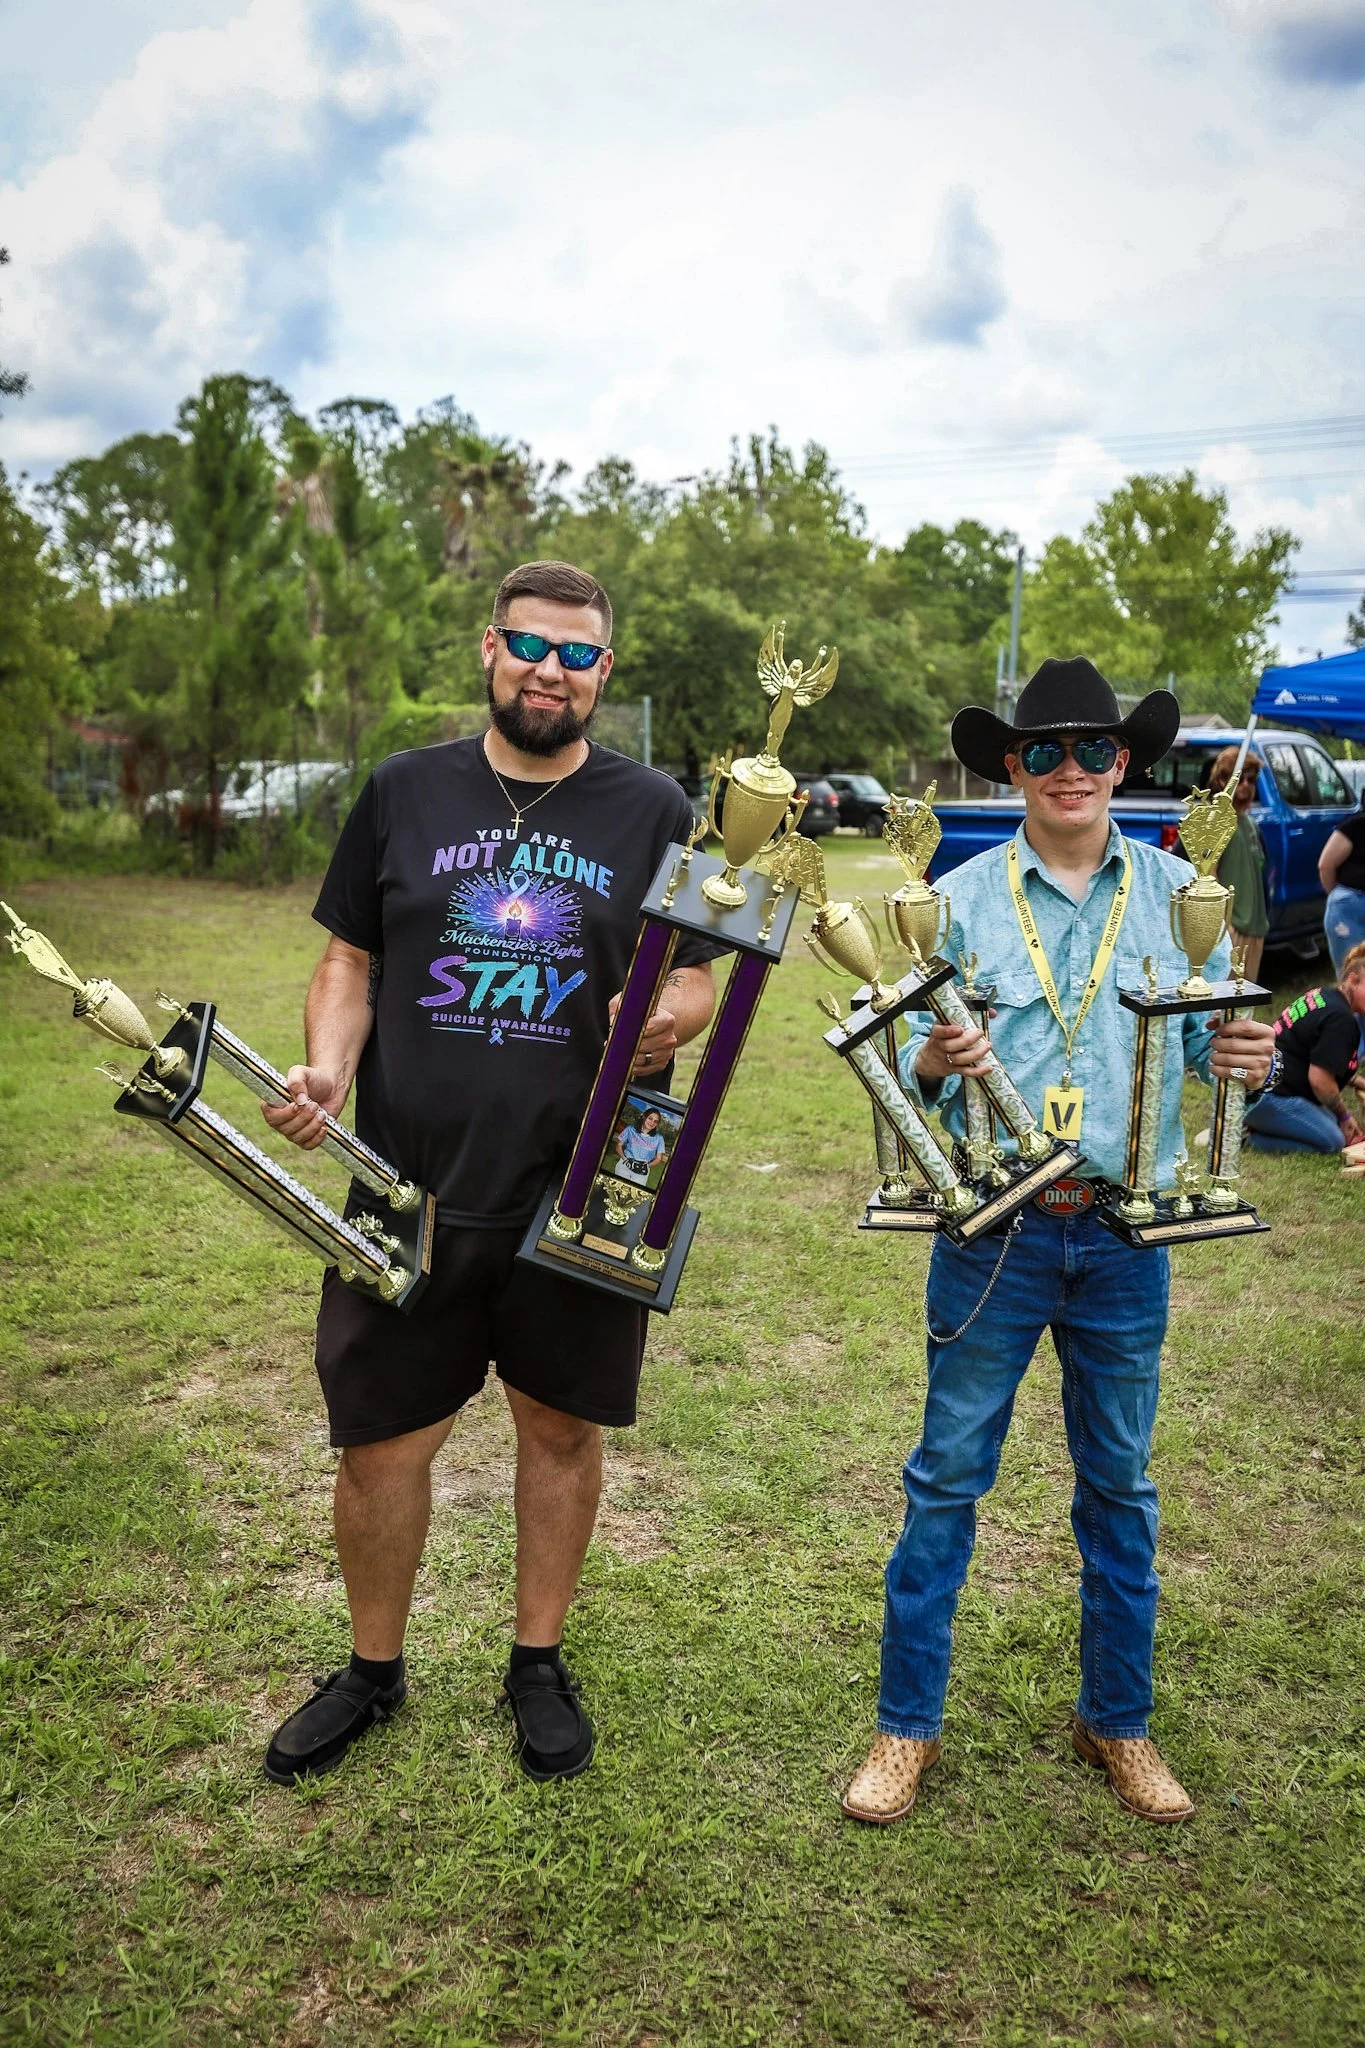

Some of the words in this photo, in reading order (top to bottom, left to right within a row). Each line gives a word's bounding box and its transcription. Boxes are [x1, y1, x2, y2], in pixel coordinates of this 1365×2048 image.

[476, 829, 518, 841] YOU
[529, 832, 572, 851] ARE
[431, 841, 502, 876] NOT
[510, 843, 614, 899] ALONE
[1014, 888, 1034, 935] VOLUNTEER
[1104, 900, 1124, 947] VOLUNTEER
[439, 929, 537, 951] Mackenzie's
[538, 940, 584, 960] Light
[464, 947, 551, 963] FOUNDATION
[416, 955, 588, 1022] STAY
[431, 1012, 486, 1026] SUICIDE
[491, 1017, 571, 1037] AWARENESS
[1050, 1101, 1077, 1131] V
[1045, 1189, 1083, 1204] DIXIE
